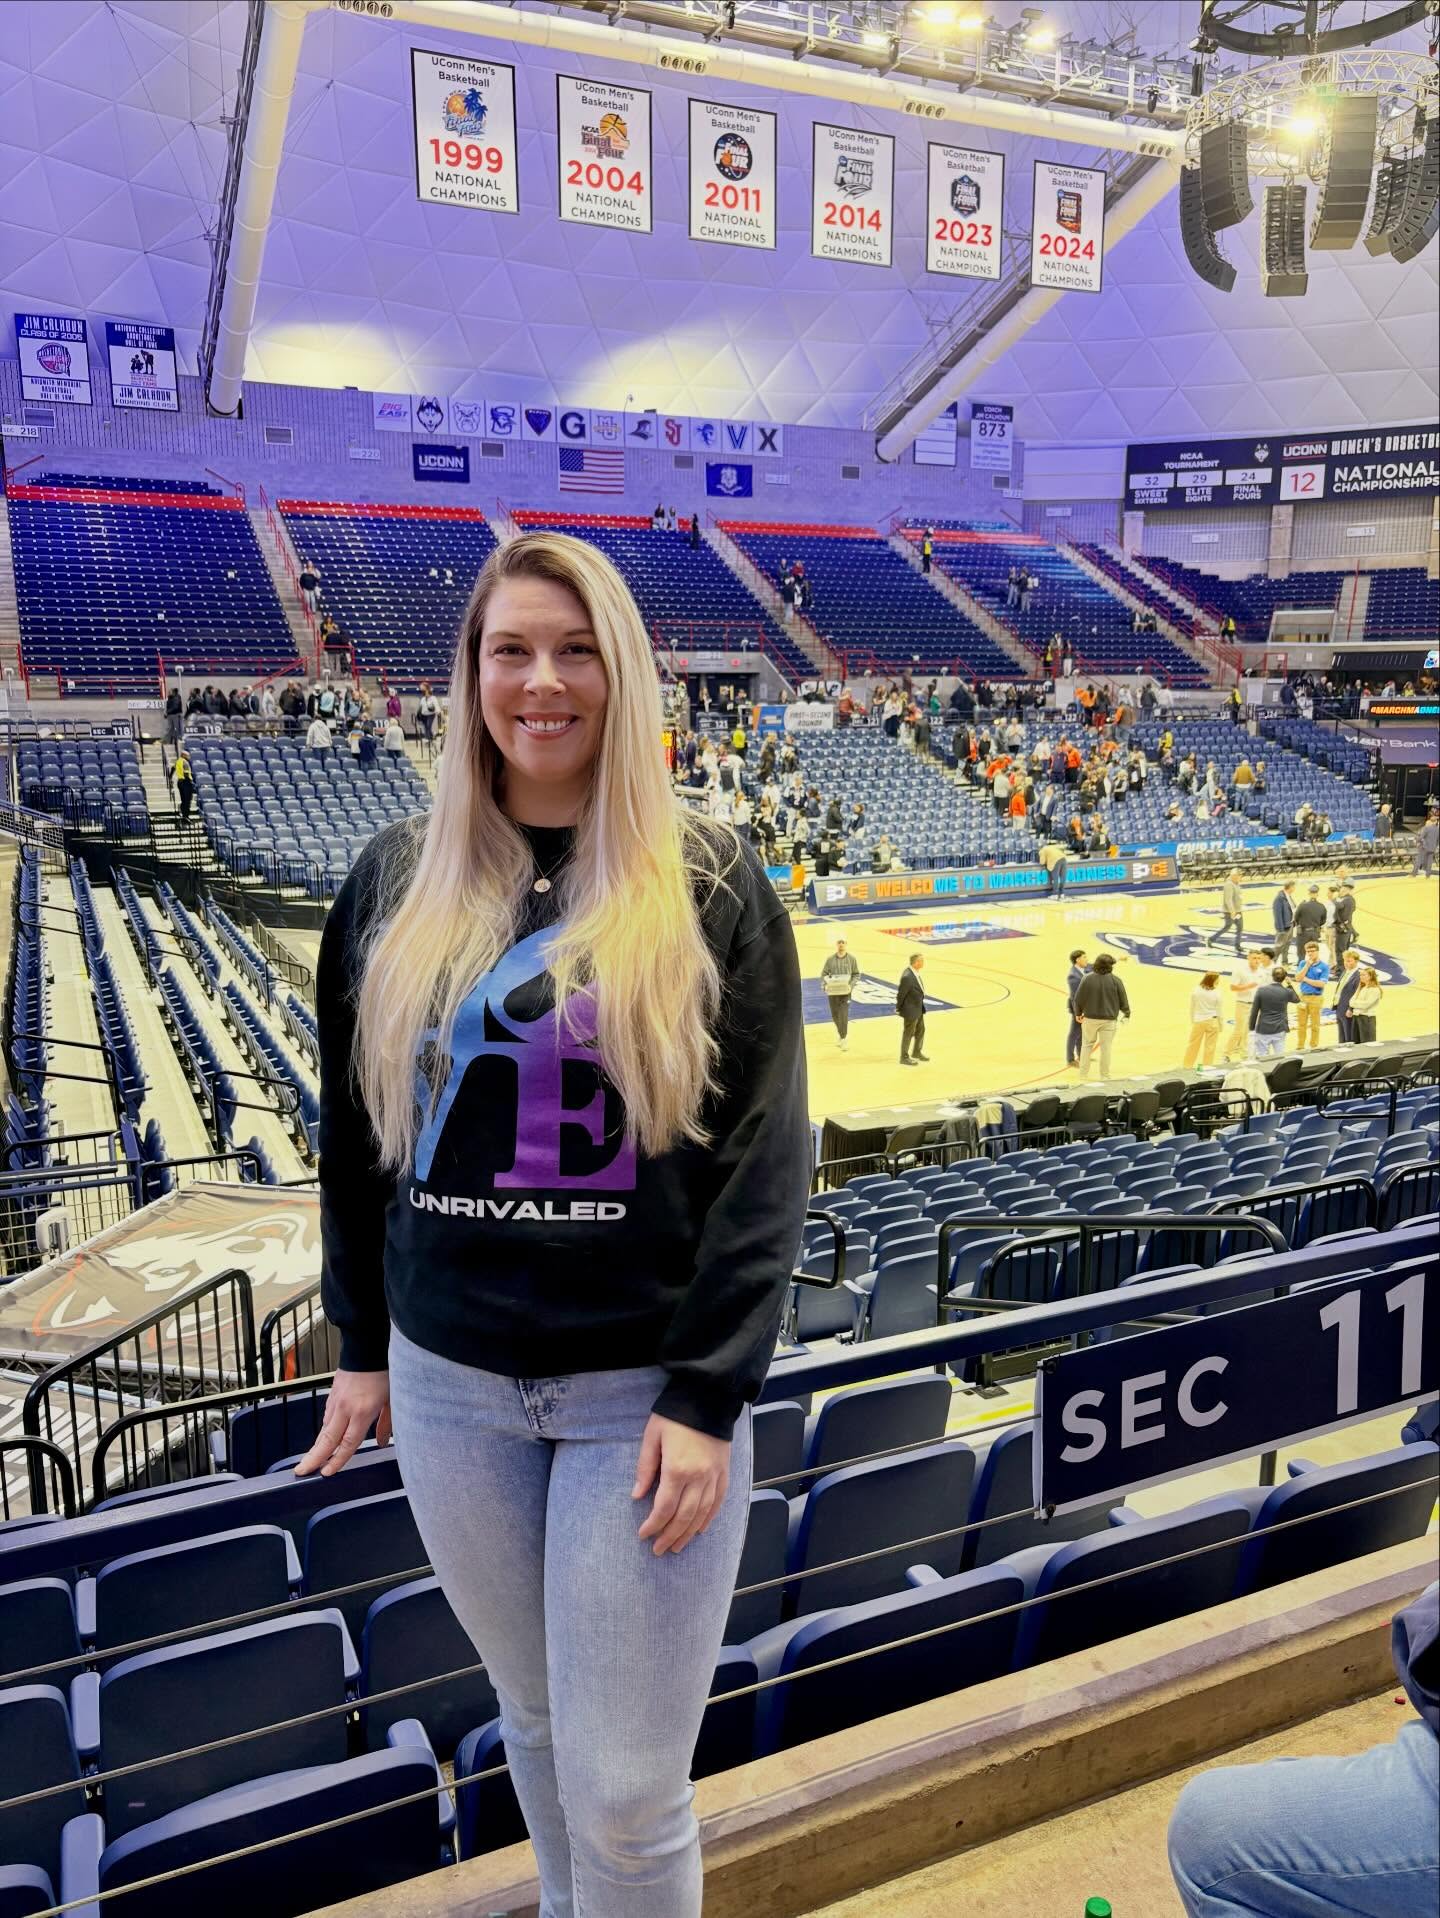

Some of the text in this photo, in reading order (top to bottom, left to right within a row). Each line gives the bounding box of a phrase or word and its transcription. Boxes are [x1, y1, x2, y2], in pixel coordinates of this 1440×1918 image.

[432, 57, 495, 75] UConn Men's
[438, 71, 490, 88] Basketball
[576, 82, 634, 100] UConn Men's
[582, 96, 628, 112] Basketball
[706, 106, 760, 122] UConn Men's
[712, 118, 756, 134] Basketball
[829, 129, 880, 145] UConn Men's
[430, 138, 503, 173] 1999
[834, 142, 874, 156] Basketball
[943, 149, 990, 163] UConn Men's
[948, 161, 986, 174] Basketball
[1048, 167, 1092, 180] UConn Men's
[435, 171, 501, 190] NATIONAL
[567, 160, 644, 195] 2004
[1052, 178, 1088, 190] Basketball
[430, 188, 506, 207] CHAMPIONS
[576, 192, 637, 211] NATIONAL
[705, 182, 760, 212] 2011
[571, 206, 641, 226] CHAMPIONS
[705, 212, 760, 228] NATIONAL
[824, 202, 882, 232] 2014
[700, 226, 766, 243] CHAMPIONS
[826, 231, 878, 246] NATIONAL
[935, 218, 992, 246] 2023
[822, 244, 882, 261] CHAMPIONS
[940, 246, 988, 261] NATIONAL
[1040, 234, 1094, 260] 2024
[936, 260, 992, 275] CHAMPIONS
[1044, 260, 1090, 274] NATIONAL
[1039, 274, 1092, 288] CHAMPIONS
[24, 316, 83, 333] JIM CALHOUN
[20, 329, 47, 337] CLASS
[120, 387, 133, 398] JIM
[560, 412, 586, 439] G
[979, 422, 1005, 437] 873
[727, 425, 747, 449] V
[758, 427, 778, 452] X
[1283, 444, 1327, 457] UCONN
[1331, 437, 1381, 455] WOMEN'S
[419, 455, 464, 468] UCONN
[1180, 452, 1203, 460] NCAA
[1164, 460, 1220, 469] TOURNAMENT
[1334, 460, 1439, 482] NATIONAL
[1145, 476, 1159, 486] 32
[1193, 474, 1207, 484] 29
[1241, 472, 1256, 481] 24
[1290, 472, 1316, 493] 12
[1186, 487, 1212, 496] ELITE
[1233, 485, 1261, 494] FINAL
[1333, 477, 1439, 493] CHAMPIONSHIPS
[1134, 489, 1168, 498] SWEET
[1233, 492, 1261, 500] FOURS
[113, 727, 130, 736] 118
[715, 720, 728, 728] 121
[1390, 740, 1437, 748] Bank
[876, 876, 958, 897] WELCOME
[964, 875, 984, 889] TO
[990, 869, 1048, 888] MARCH
[1066, 864, 1126, 882] ADNESS
[410, 1187, 626, 1220] UNRIVALED
[1060, 1273, 1425, 1463] SEC 11
